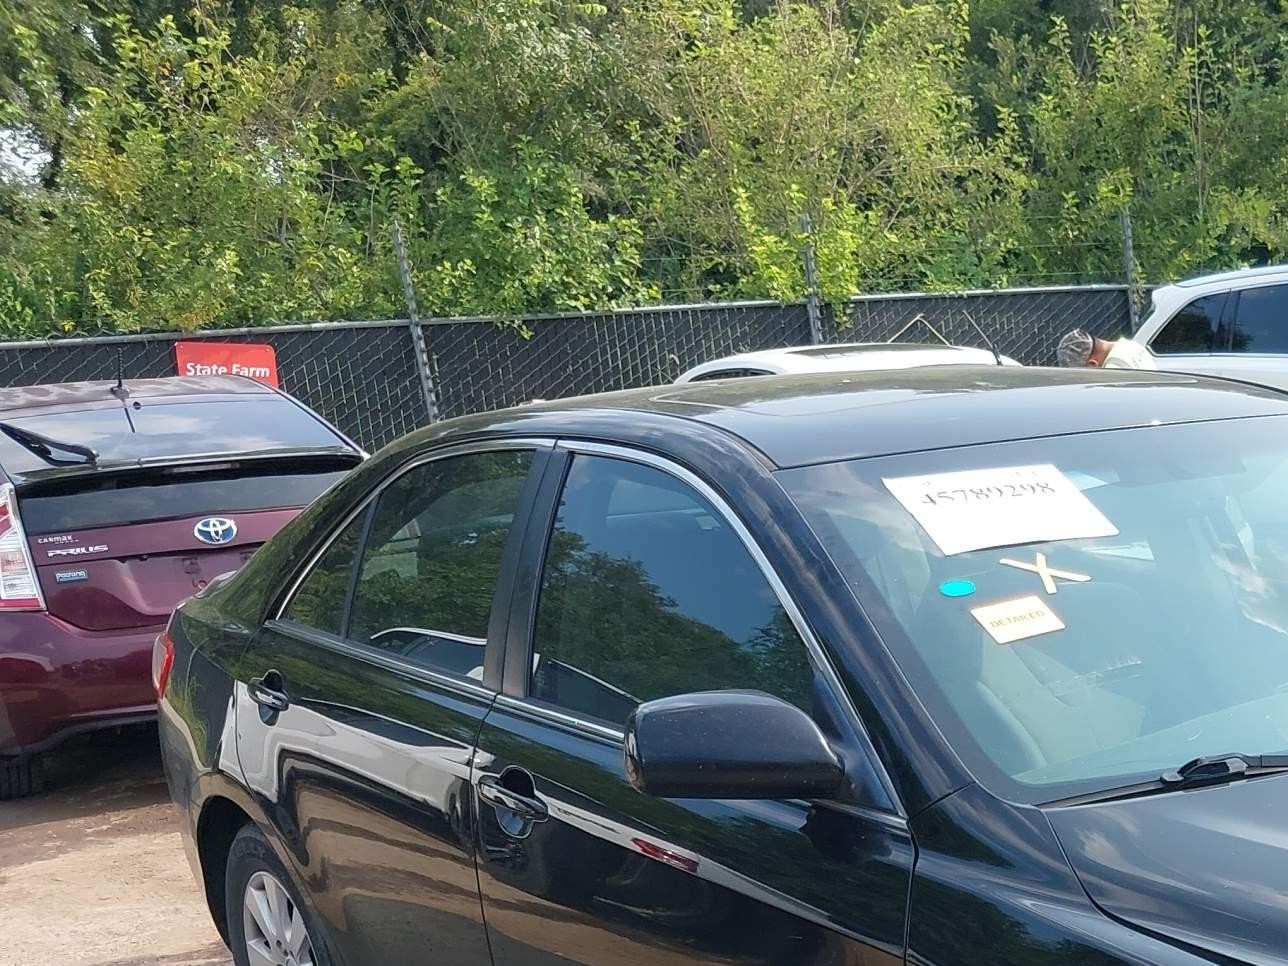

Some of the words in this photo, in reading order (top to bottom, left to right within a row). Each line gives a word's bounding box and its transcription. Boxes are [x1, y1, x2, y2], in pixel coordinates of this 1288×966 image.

[186, 362, 228, 376] State
[231, 363, 270, 378] Farm
[47, 544, 109, 558] PRIUS
